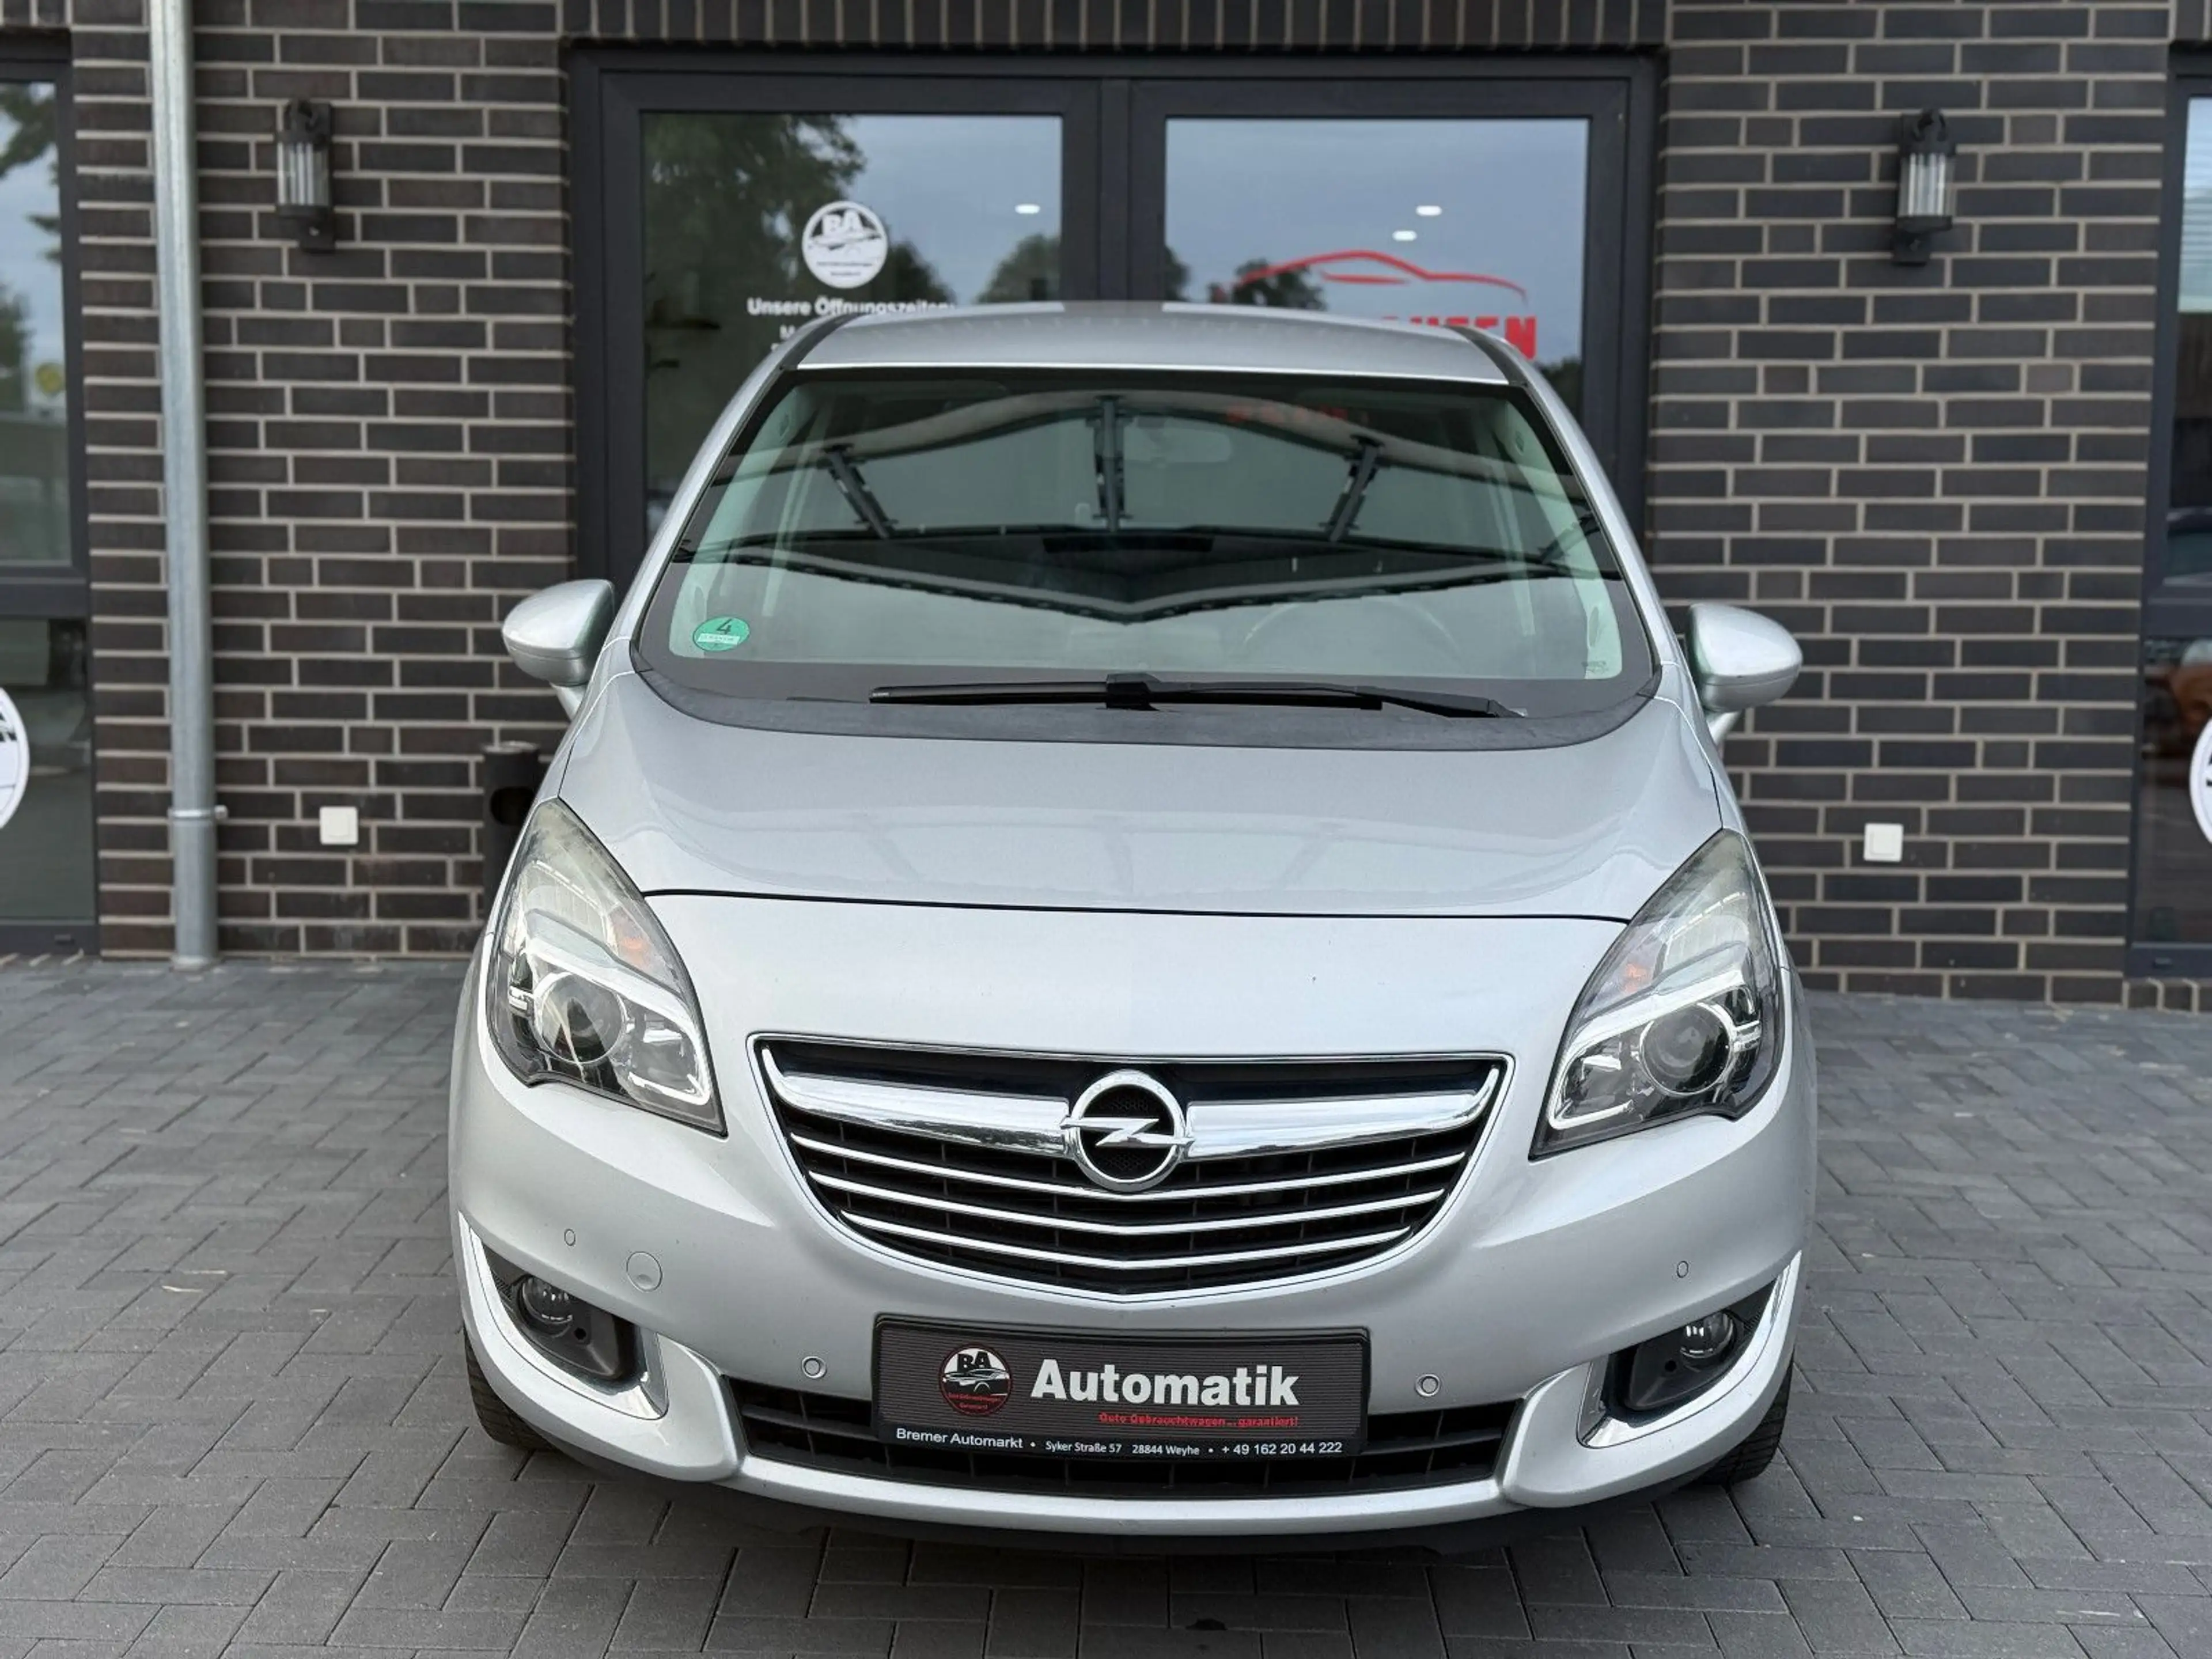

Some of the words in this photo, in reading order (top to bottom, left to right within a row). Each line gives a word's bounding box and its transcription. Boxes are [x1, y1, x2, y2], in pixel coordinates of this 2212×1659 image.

[747, 297, 812, 316] Unsere
[716, 618, 732, 635] 4
[957, 1351, 991, 1373] BA
[1030, 1358, 1300, 1406] Automatik
[896, 1427, 948, 1443] Bremer
[950, 1433, 1023, 1448] Automarkt
[1045, 1441, 1073, 1453] Syker
[1074, 1442, 1107, 1452] Straße
[1108, 1444, 1122, 1453] 57
[1132, 1444, 1162, 1455] 28844
[1165, 1445, 1200, 1457] Weyhe
[1233, 1444, 1249, 1455] 49
[1253, 1443, 1277, 1455] 162
[1280, 1442, 1296, 1455] 20
[1299, 1442, 1316, 1454] 44
[1319, 1441, 1343, 1453] 222
